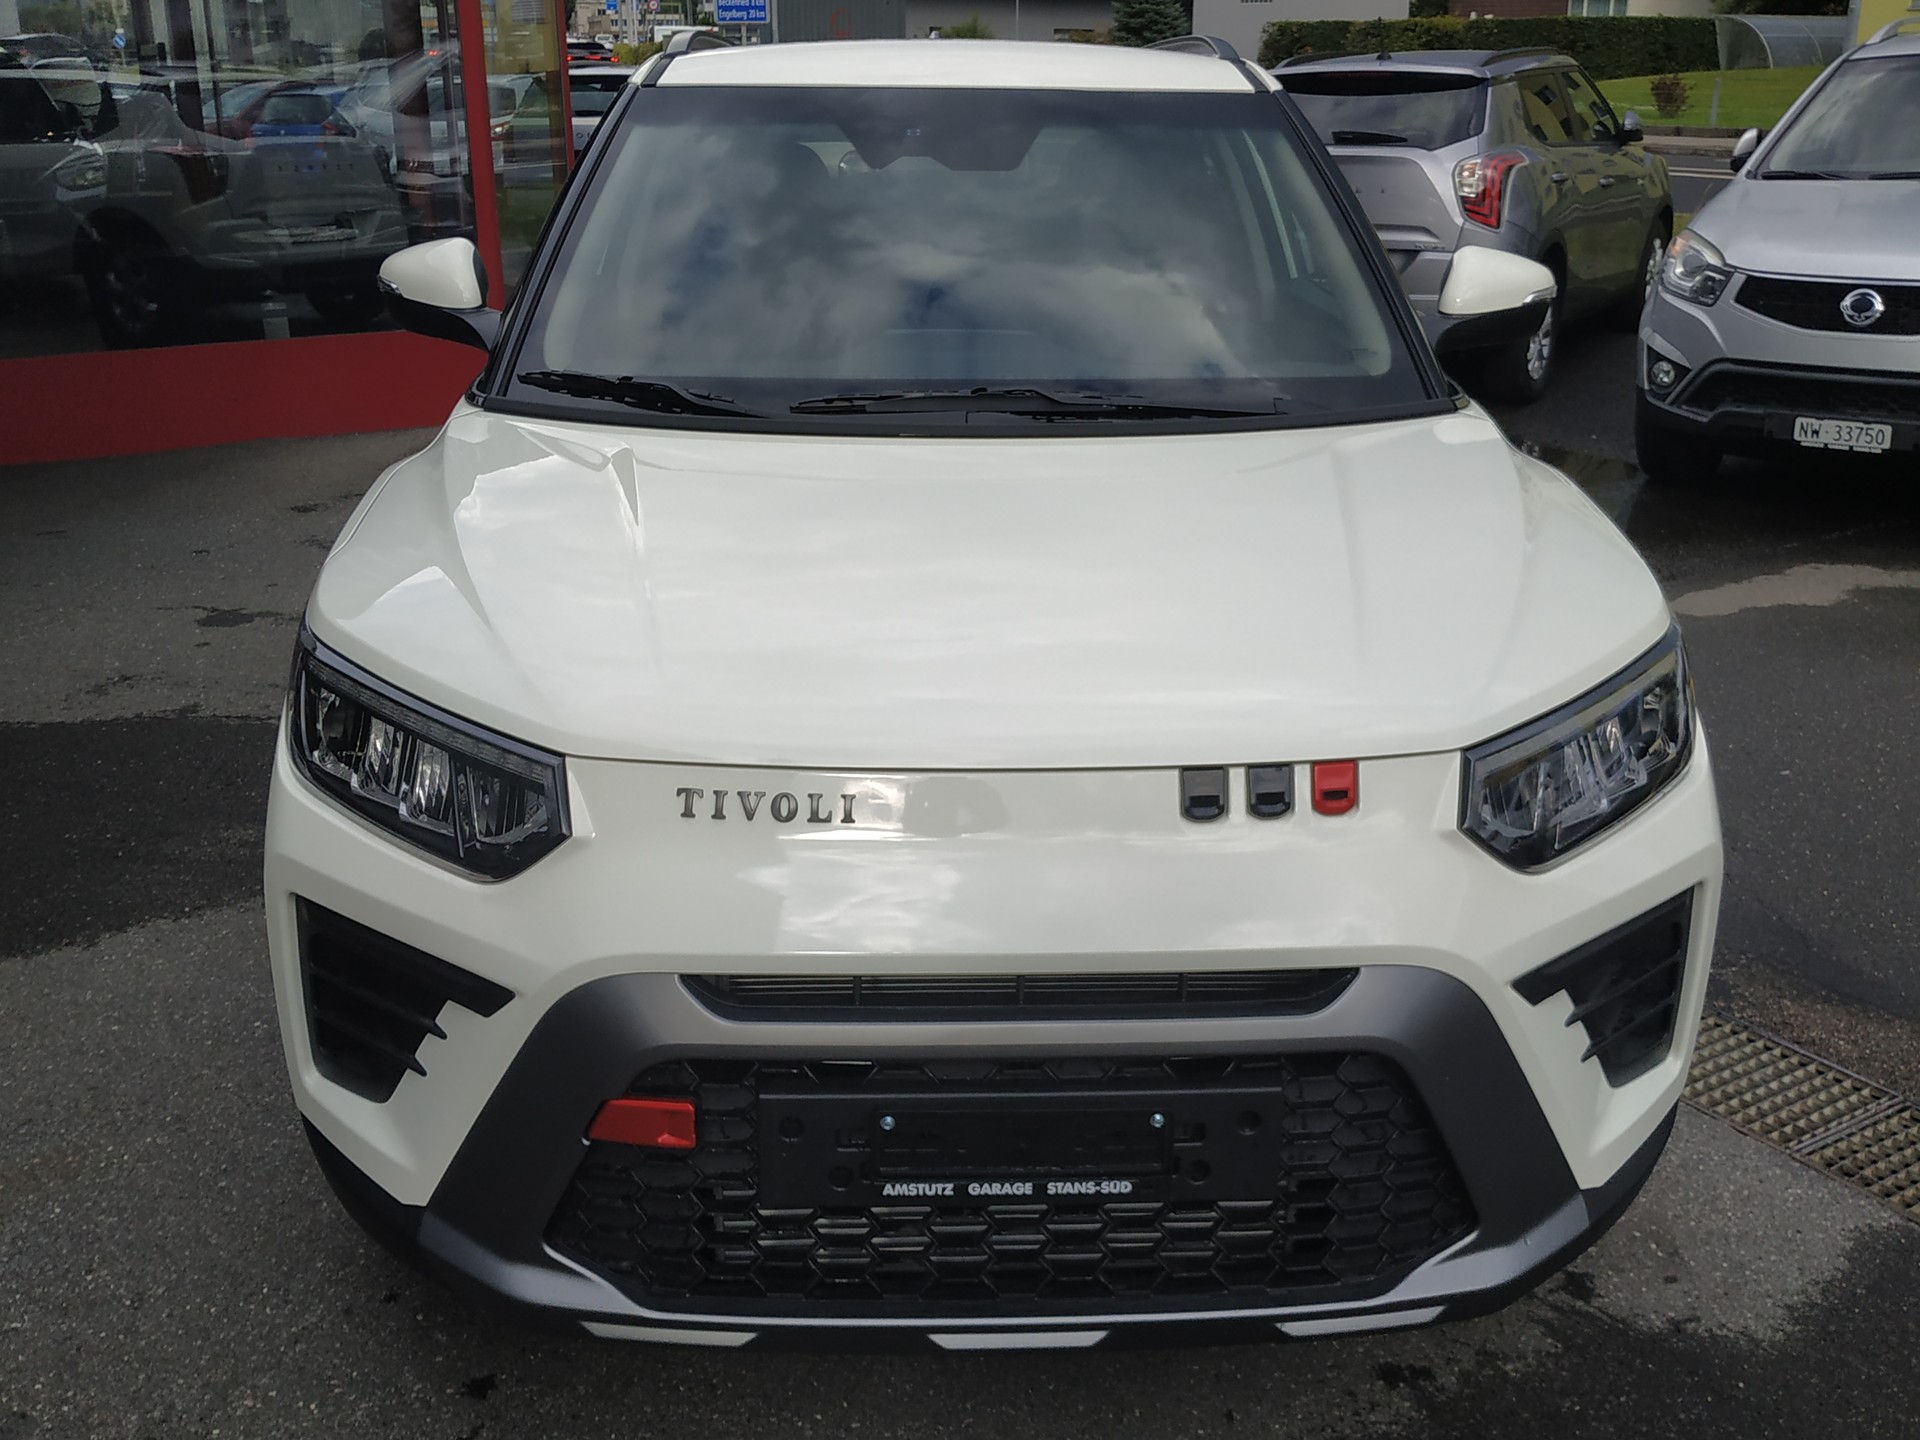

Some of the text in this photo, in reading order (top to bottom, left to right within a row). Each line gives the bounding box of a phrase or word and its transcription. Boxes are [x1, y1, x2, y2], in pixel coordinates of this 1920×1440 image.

[719, 9, 765, 20] Engelberg 20 km
[1799, 422, 1885, 446] NW 33750
[676, 787, 857, 823] TIVOLI
[882, 1180, 1133, 1196] AMSTUTZ GARAGE STANS-SÜD
